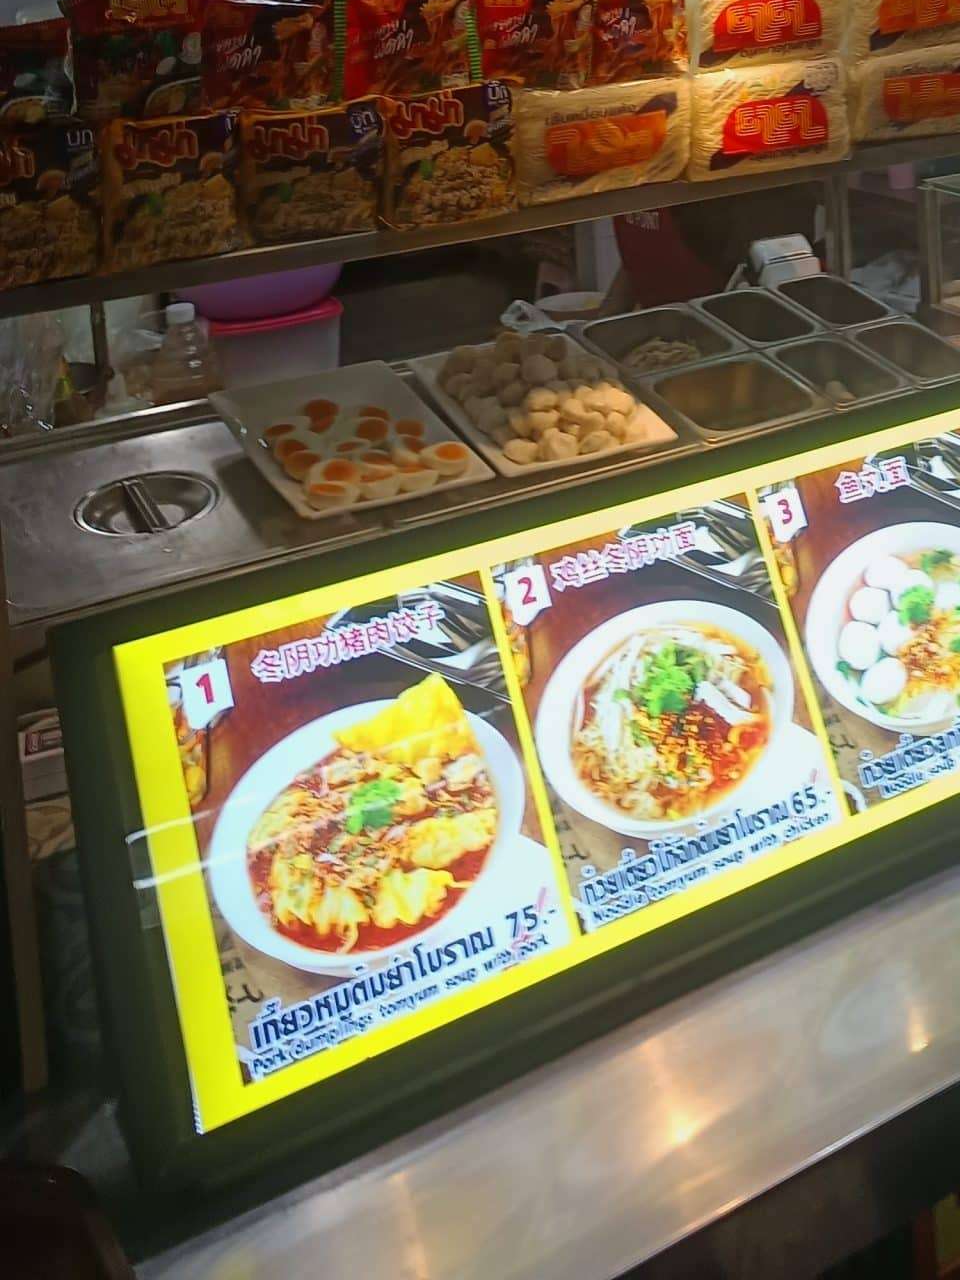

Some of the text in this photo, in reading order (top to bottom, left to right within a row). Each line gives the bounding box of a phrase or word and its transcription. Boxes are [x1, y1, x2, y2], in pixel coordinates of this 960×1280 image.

[836, 456, 908, 502] 鱼丸面
[778, 498, 793, 526] 3
[518, 577, 537, 605] 2
[253, 602, 443, 682] 冬阴功猪肉饺子
[195, 673, 215, 704] 1
[651, 814, 829, 896] tomyum soup with chicken
[253, 927, 494, 1048] เกี๊ยวหมูต้มยำโบราณ
[253, 951, 512, 1076] Pork tomyum soup with
